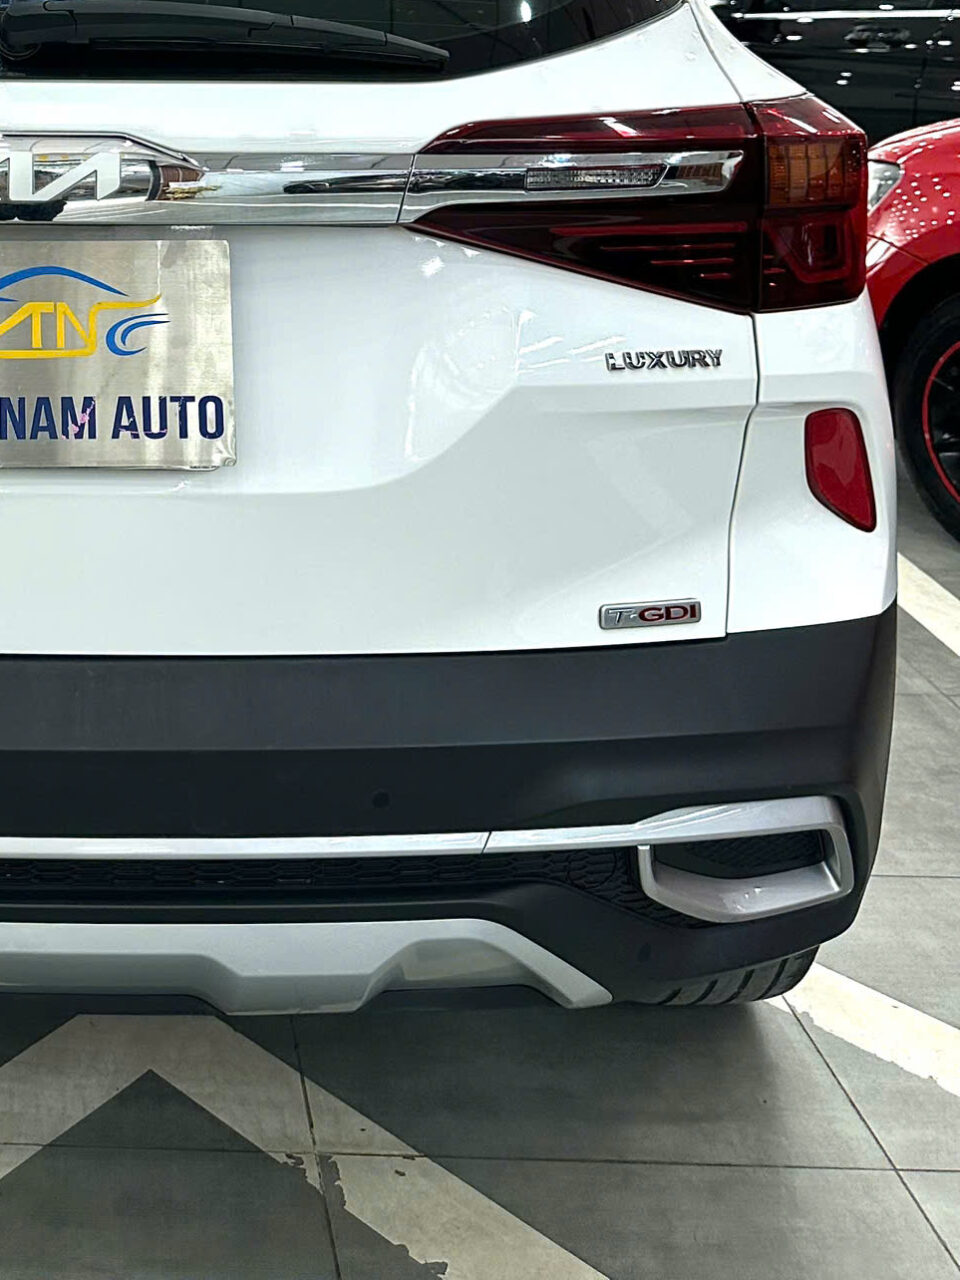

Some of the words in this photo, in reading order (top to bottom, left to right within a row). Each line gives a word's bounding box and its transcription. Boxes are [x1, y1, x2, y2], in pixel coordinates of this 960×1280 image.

[605, 349, 723, 371] LUXURY
[0, 396, 97, 441] NAM
[111, 395, 226, 440] AUTO
[608, 604, 697, 624] T-GDI
